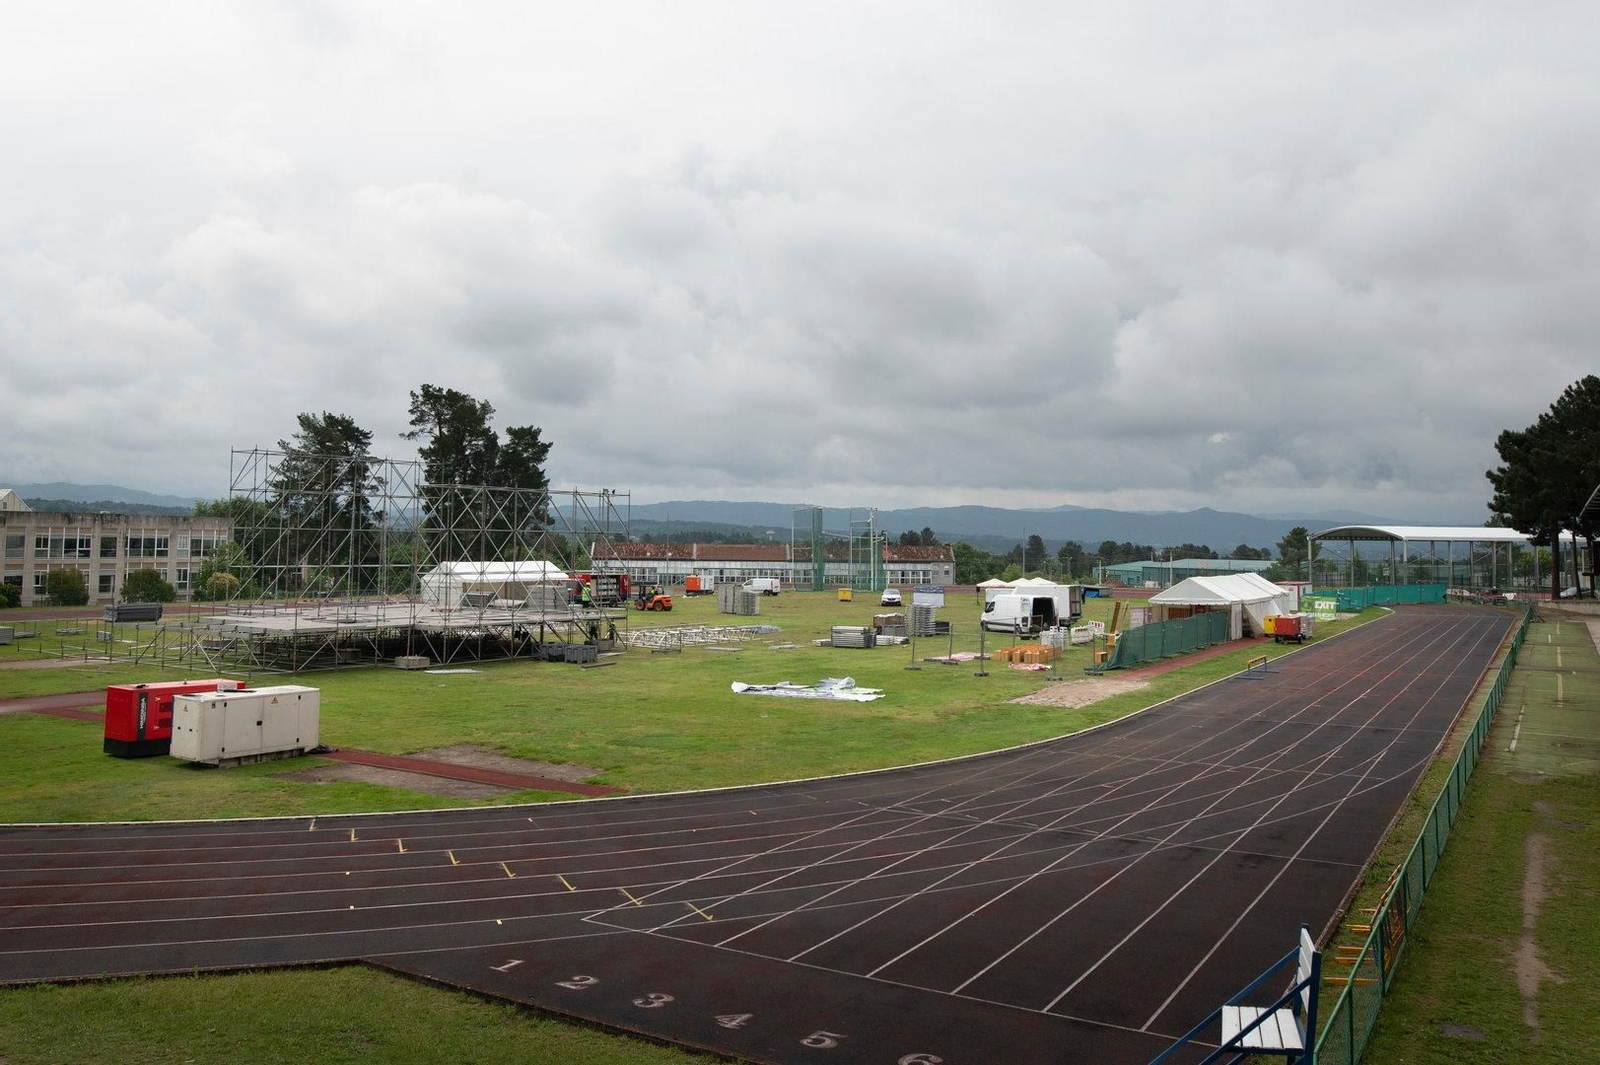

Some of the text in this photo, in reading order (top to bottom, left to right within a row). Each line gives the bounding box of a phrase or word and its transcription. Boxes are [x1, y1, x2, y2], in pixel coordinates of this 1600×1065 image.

[1314, 600, 1337, 609] EXIT
[489, 959, 525, 973] 1
[554, 975, 599, 990] 2
[633, 993, 675, 1008] 3
[714, 1013, 754, 1029] 4
[801, 1031, 848, 1049] 5
